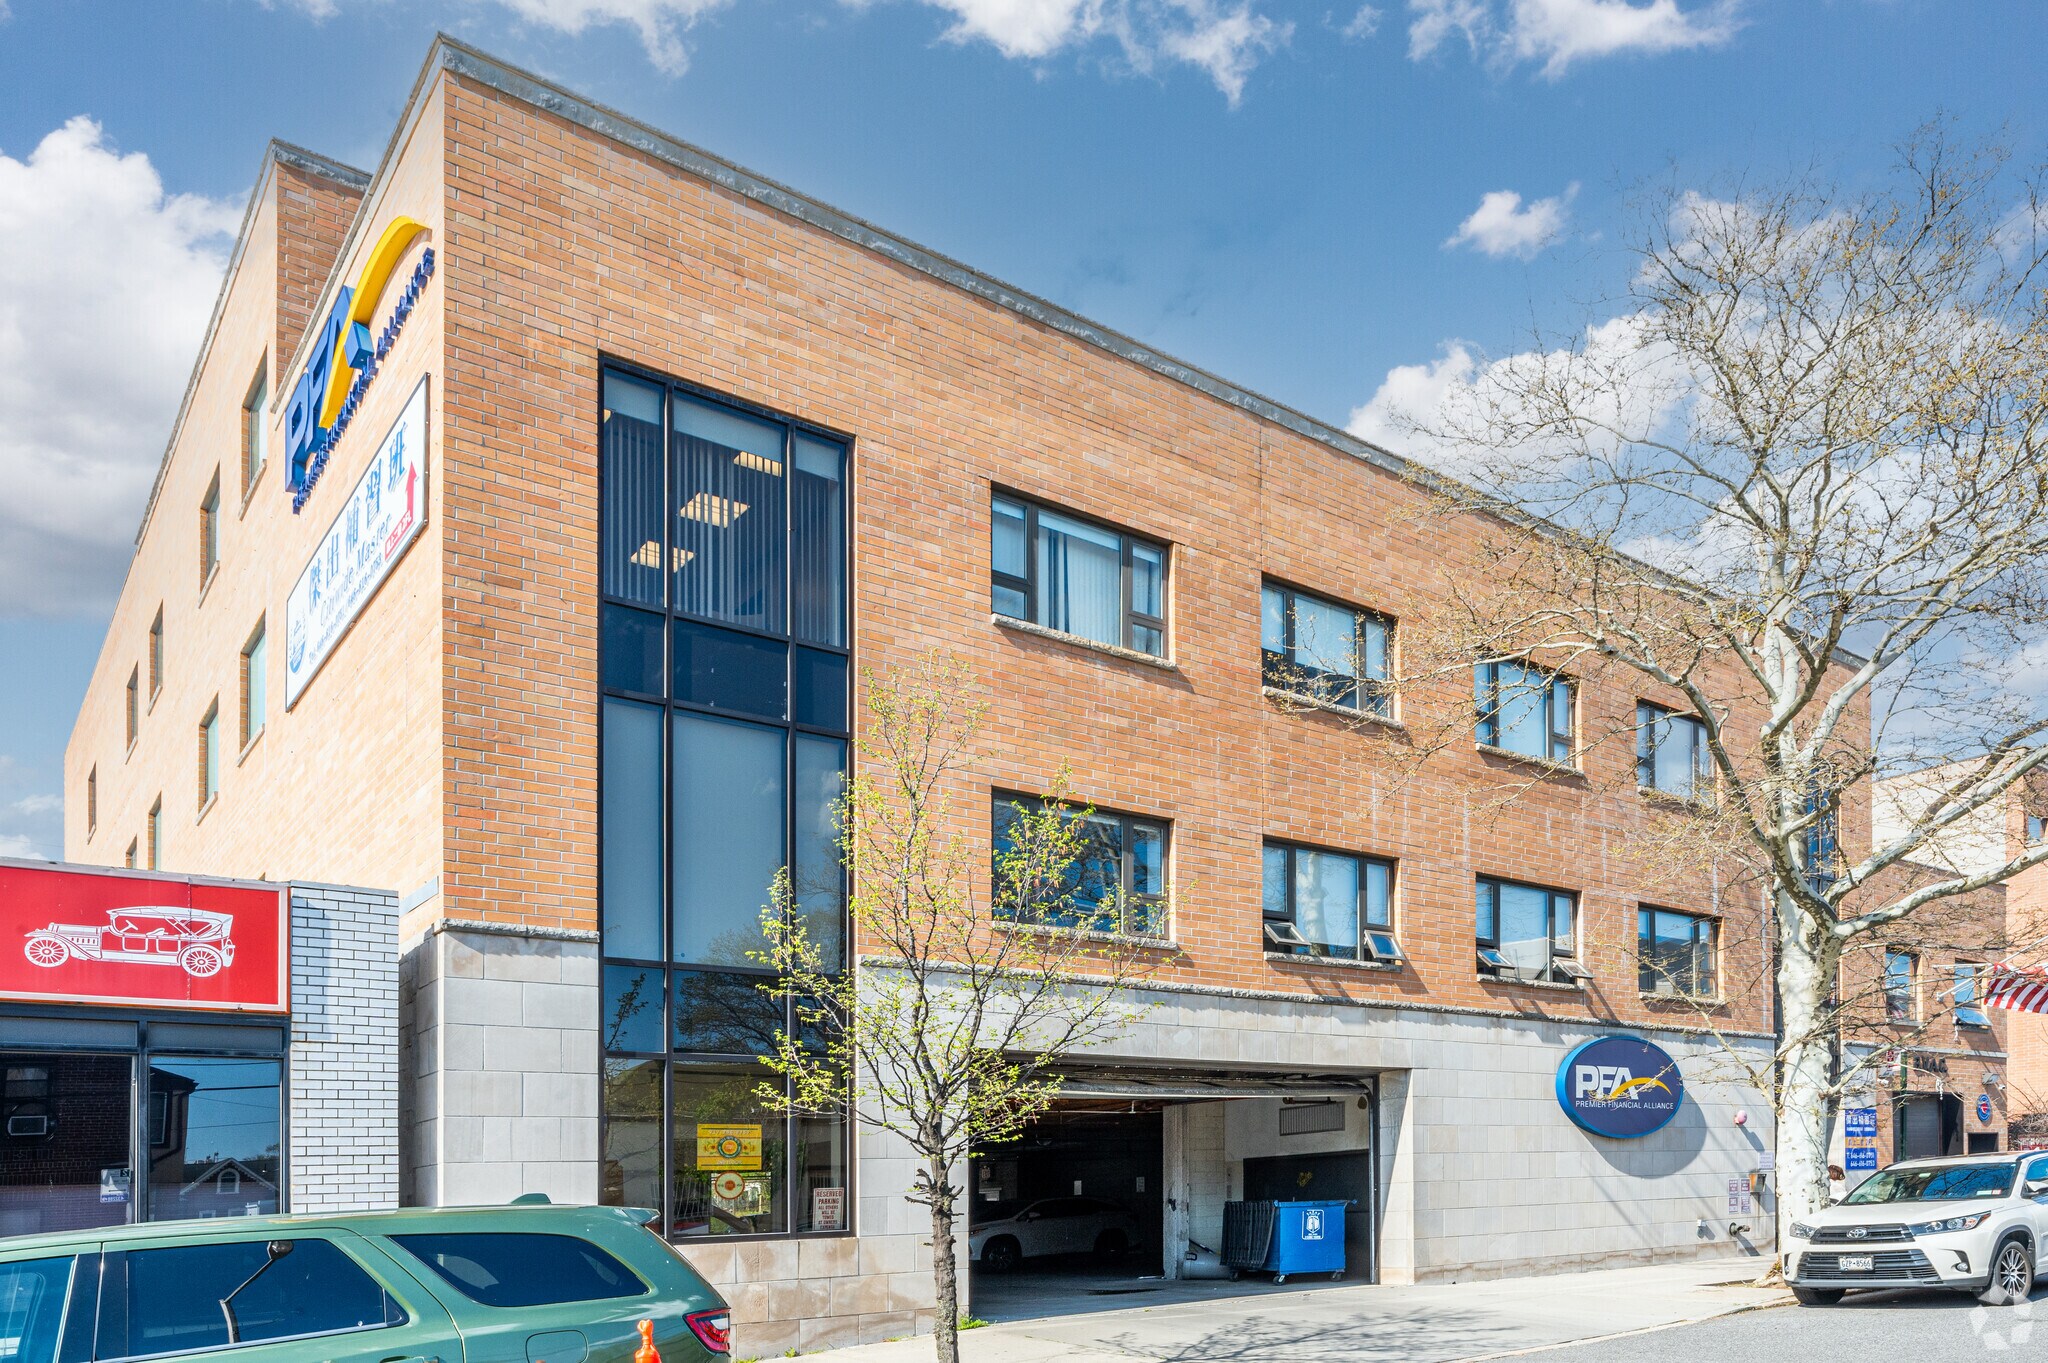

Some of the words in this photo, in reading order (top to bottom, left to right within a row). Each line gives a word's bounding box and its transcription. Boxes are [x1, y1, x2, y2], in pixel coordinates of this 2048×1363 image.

[285, 285, 374, 494] PFA
[309, 421, 407, 615] 傑出補習班
[356, 513, 392, 575] Master
[1575, 1100, 1606, 1108] PREMIER
[1608, 1101, 1642, 1109] FINANCIAL
[1643, 1102, 1674, 1110] ALLIANCE
[1576, 1065, 1639, 1100] PFA
